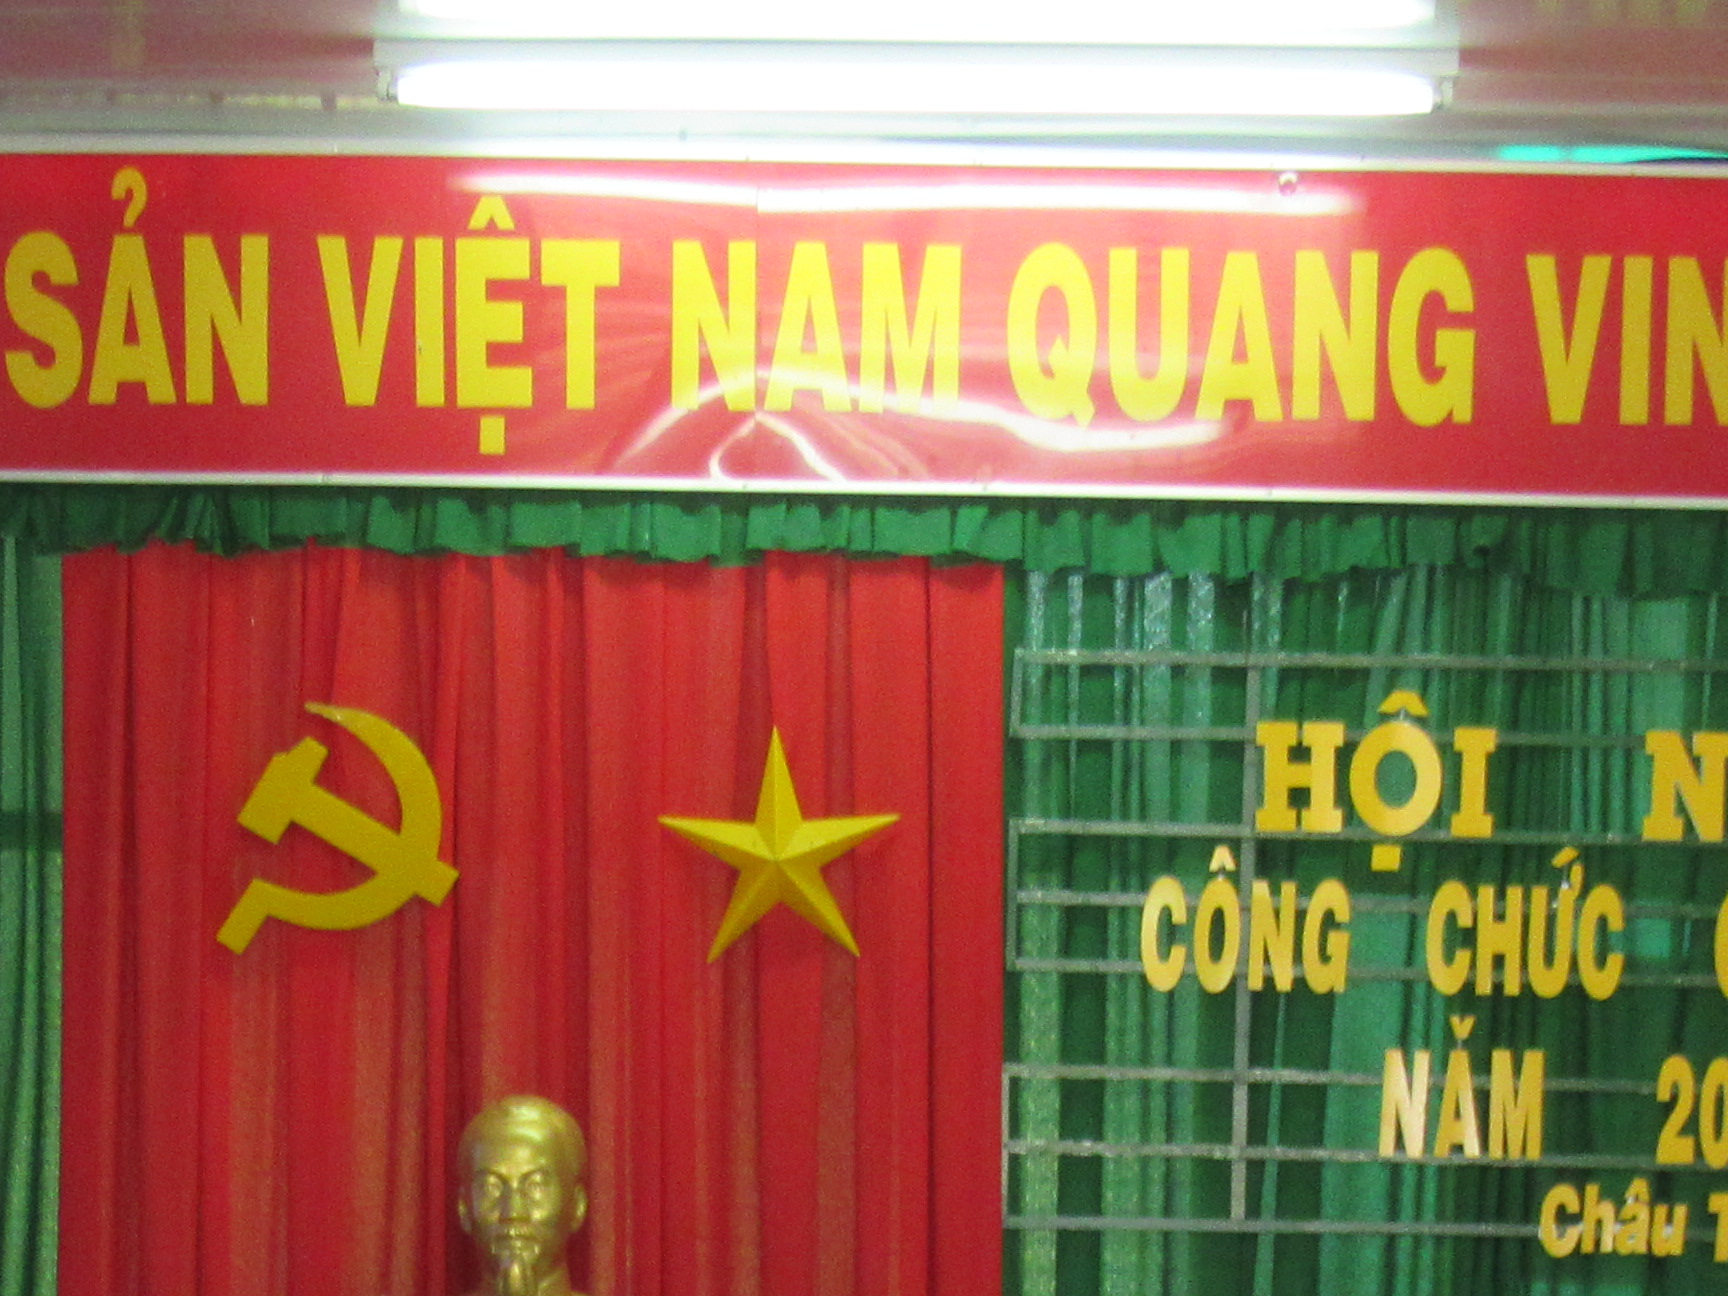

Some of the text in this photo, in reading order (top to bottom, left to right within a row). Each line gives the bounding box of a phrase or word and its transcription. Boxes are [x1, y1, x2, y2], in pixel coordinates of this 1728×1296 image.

[4, 168, 270, 409] SẢN
[317, 194, 622, 455] VIỆT
[671, 240, 964, 413] NAM
[1006, 240, 1476, 427] QUANG
[1255, 690, 1497, 872] HỘI
[1140, 844, 1353, 995] CÔNG
[1426, 846, 1626, 1001] CHỨC
[1378, 1015, 1546, 1161] NĂM
[1539, 1177, 1688, 1258] Châu
